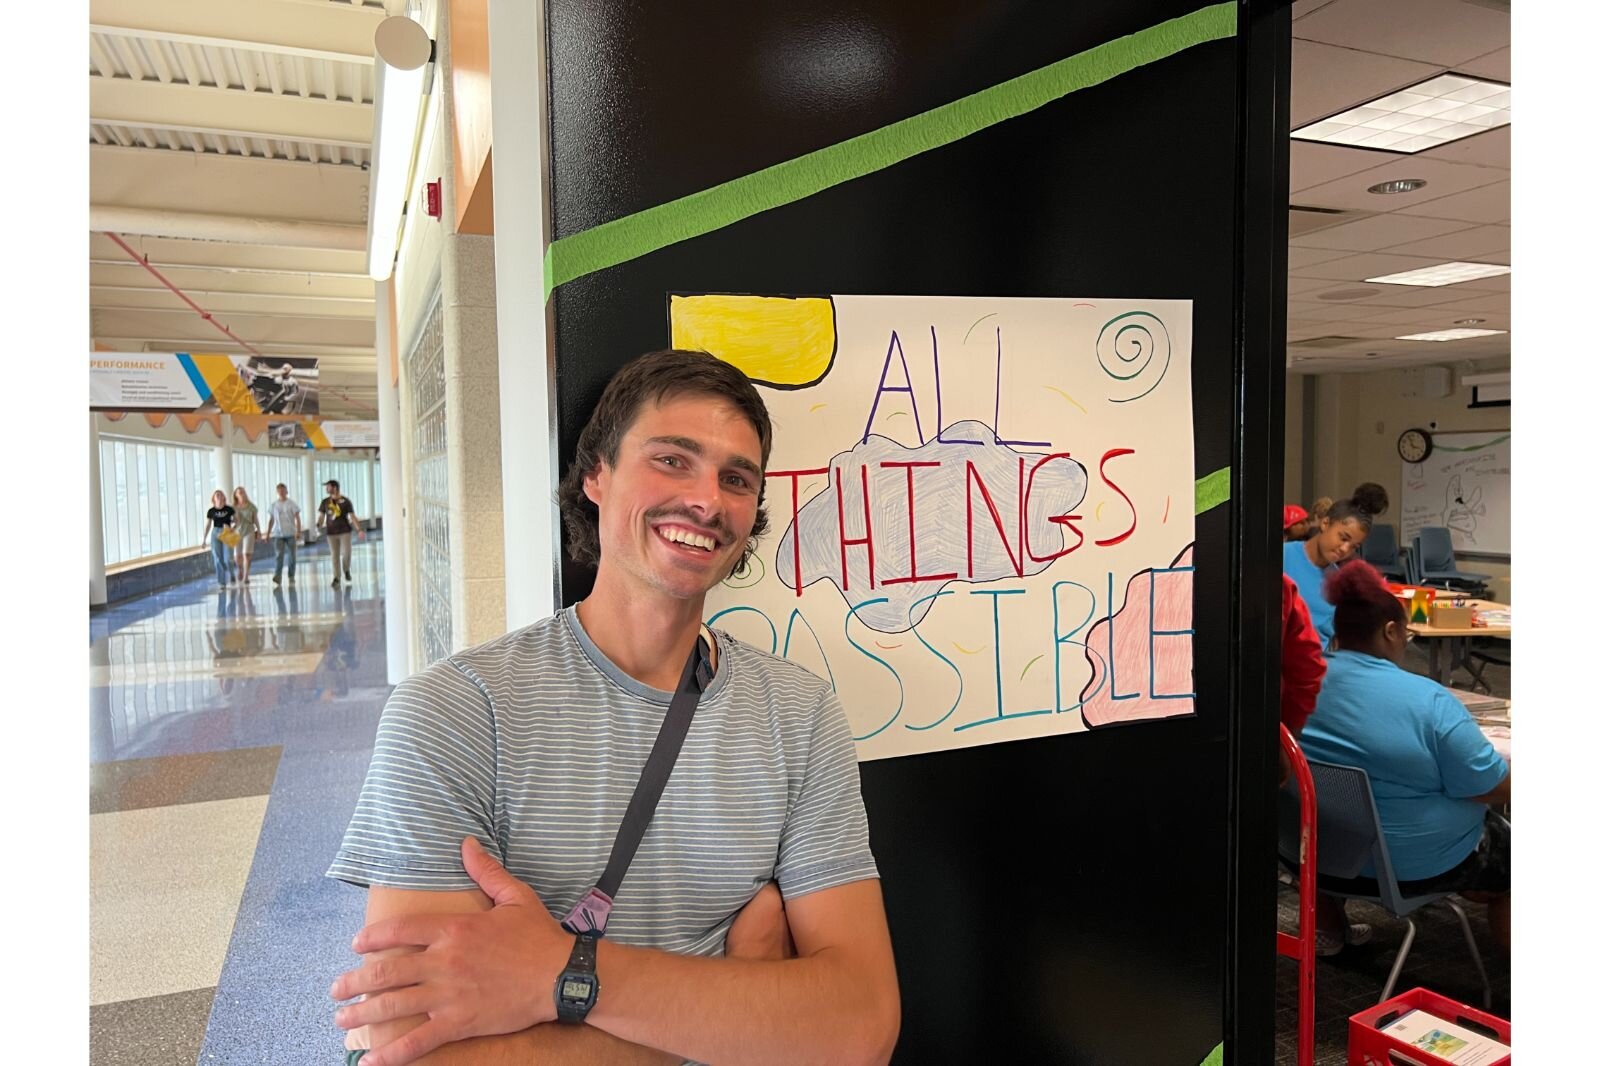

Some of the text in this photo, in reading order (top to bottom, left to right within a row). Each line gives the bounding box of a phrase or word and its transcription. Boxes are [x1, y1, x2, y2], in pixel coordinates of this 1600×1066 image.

[90, 360, 166, 369] PERFORMANCE
[863, 325, 1052, 446] ALL
[764, 448, 1138, 597] THINGS
